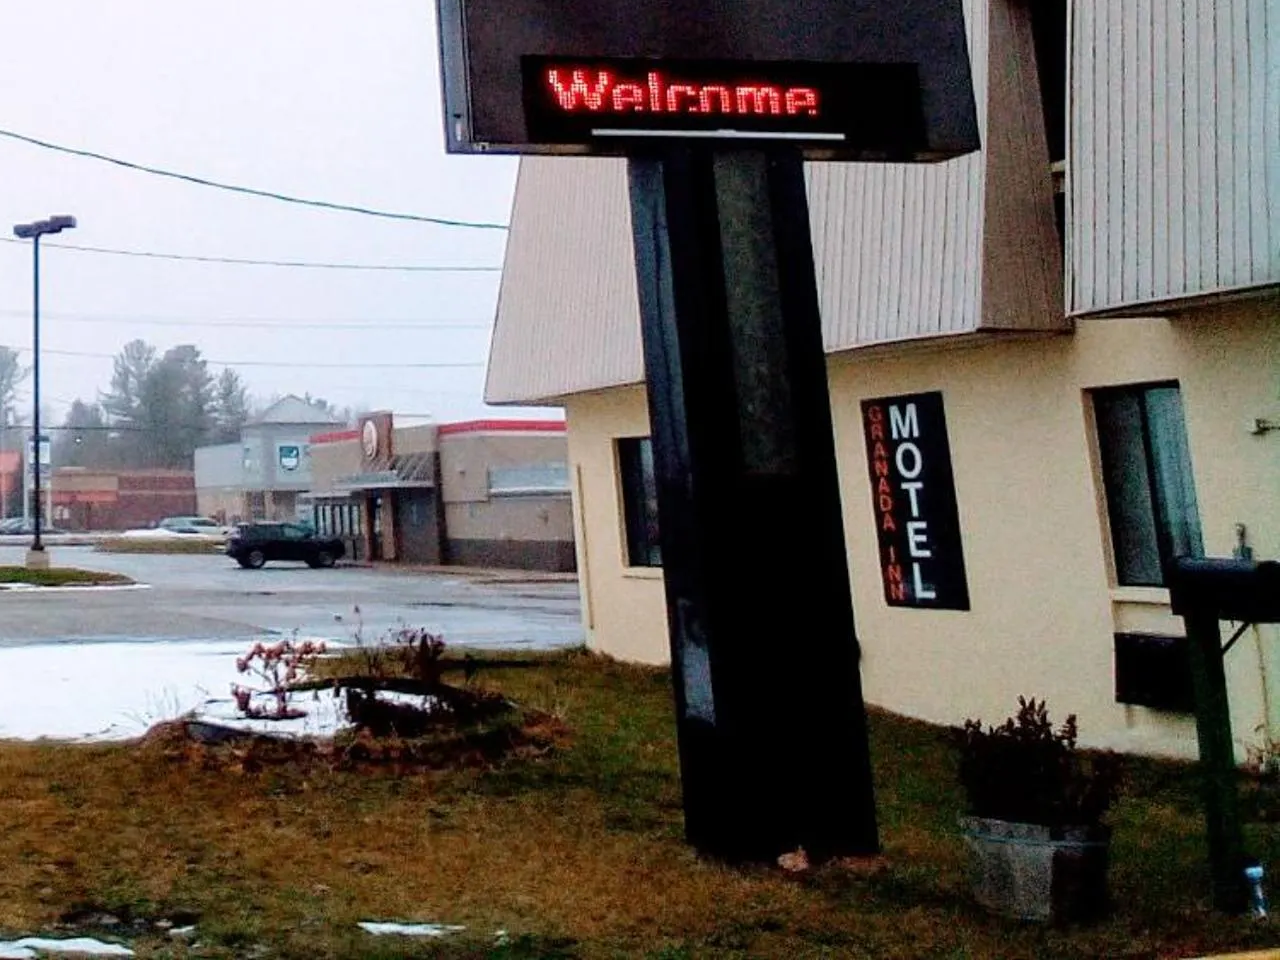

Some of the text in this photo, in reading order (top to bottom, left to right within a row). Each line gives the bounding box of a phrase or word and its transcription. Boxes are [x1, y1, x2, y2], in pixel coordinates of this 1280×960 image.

[869, 405, 906, 601] GRANADA INN
[888, 402, 937, 600] MOTEL
